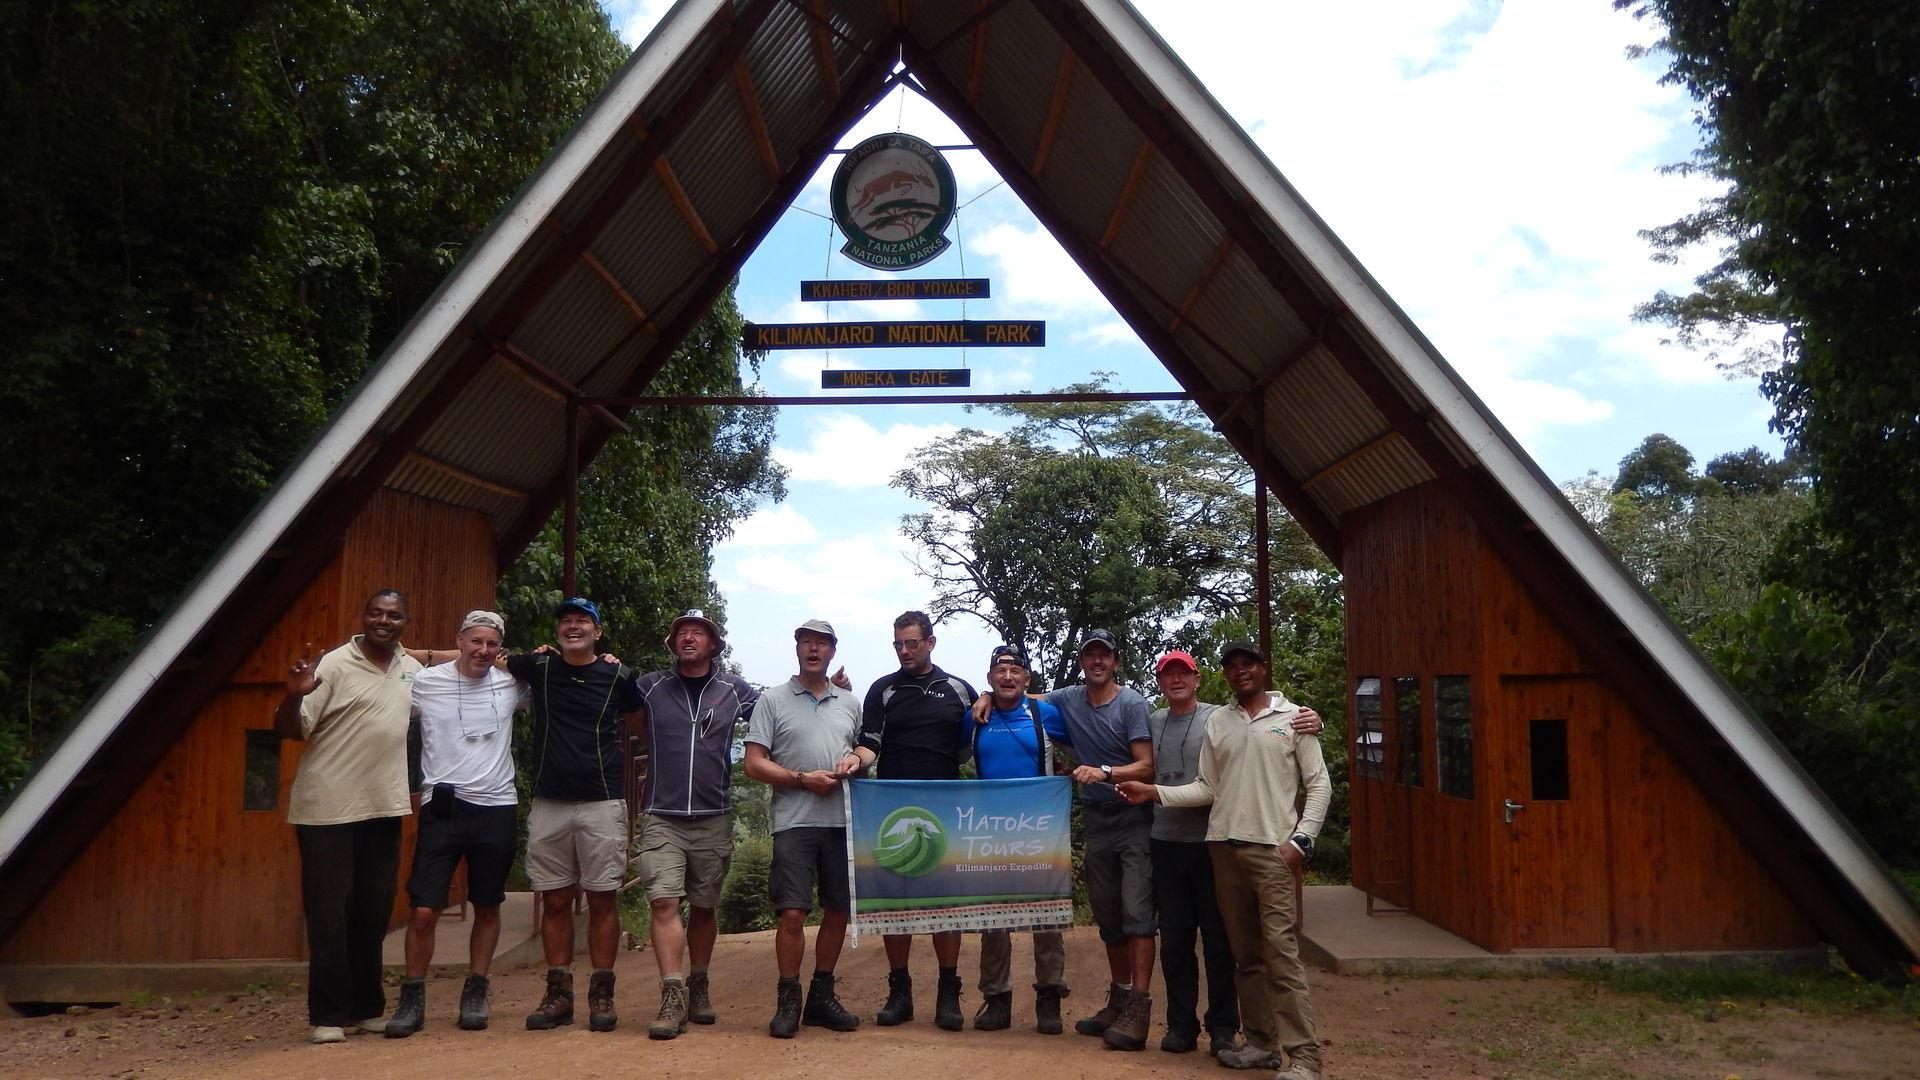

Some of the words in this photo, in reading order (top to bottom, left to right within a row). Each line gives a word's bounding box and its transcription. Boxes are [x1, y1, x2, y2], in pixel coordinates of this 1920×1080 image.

[888, 138, 903, 146] ZA
[908, 139, 936, 163] TAIFA
[851, 245, 906, 265] NATIONAL
[909, 238, 944, 262] PARKS
[867, 235, 927, 253] TANZANIA
[887, 282, 915, 297] BON
[922, 281, 975, 296] VOYAGE
[758, 325, 875, 345] KILIMANJARO
[887, 324, 972, 343] NATIONAL
[985, 324, 1031, 343] PARK
[843, 371, 896, 387] MWEKA
[909, 370, 950, 386] GATE
[956, 806, 1054, 832] MATOKE
[961, 835, 1044, 860] TOURS
[955, 864, 1007, 873] Kilimanjaro
[1009, 862, 1053, 873] Expeditie
